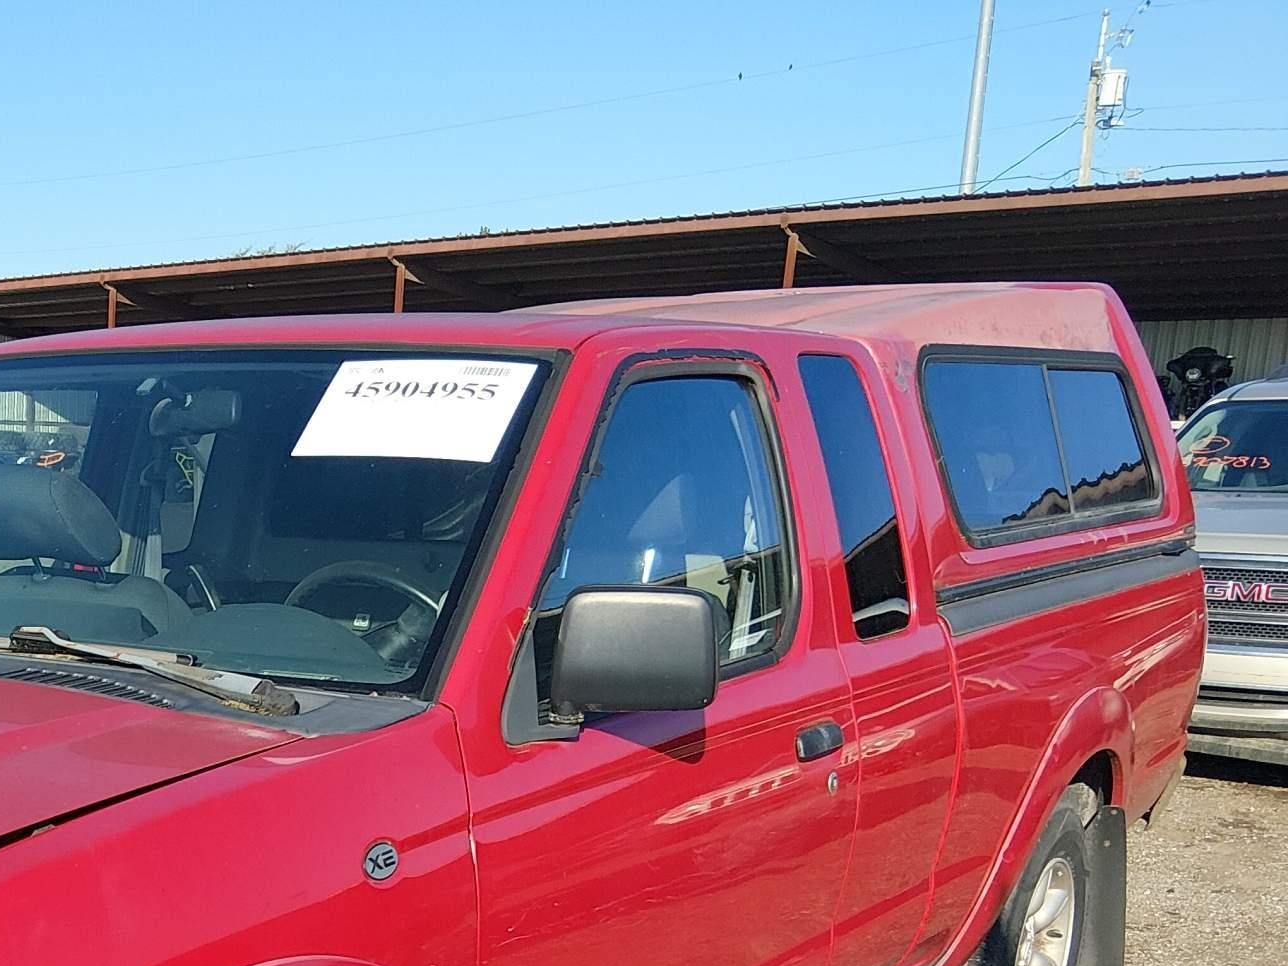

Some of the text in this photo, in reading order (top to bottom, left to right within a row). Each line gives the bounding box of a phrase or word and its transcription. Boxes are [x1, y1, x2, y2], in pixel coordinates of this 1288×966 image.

[344, 381, 500, 401] 45904955
[1203, 580, 1288, 604] GMC
[367, 848, 397, 875] XE
